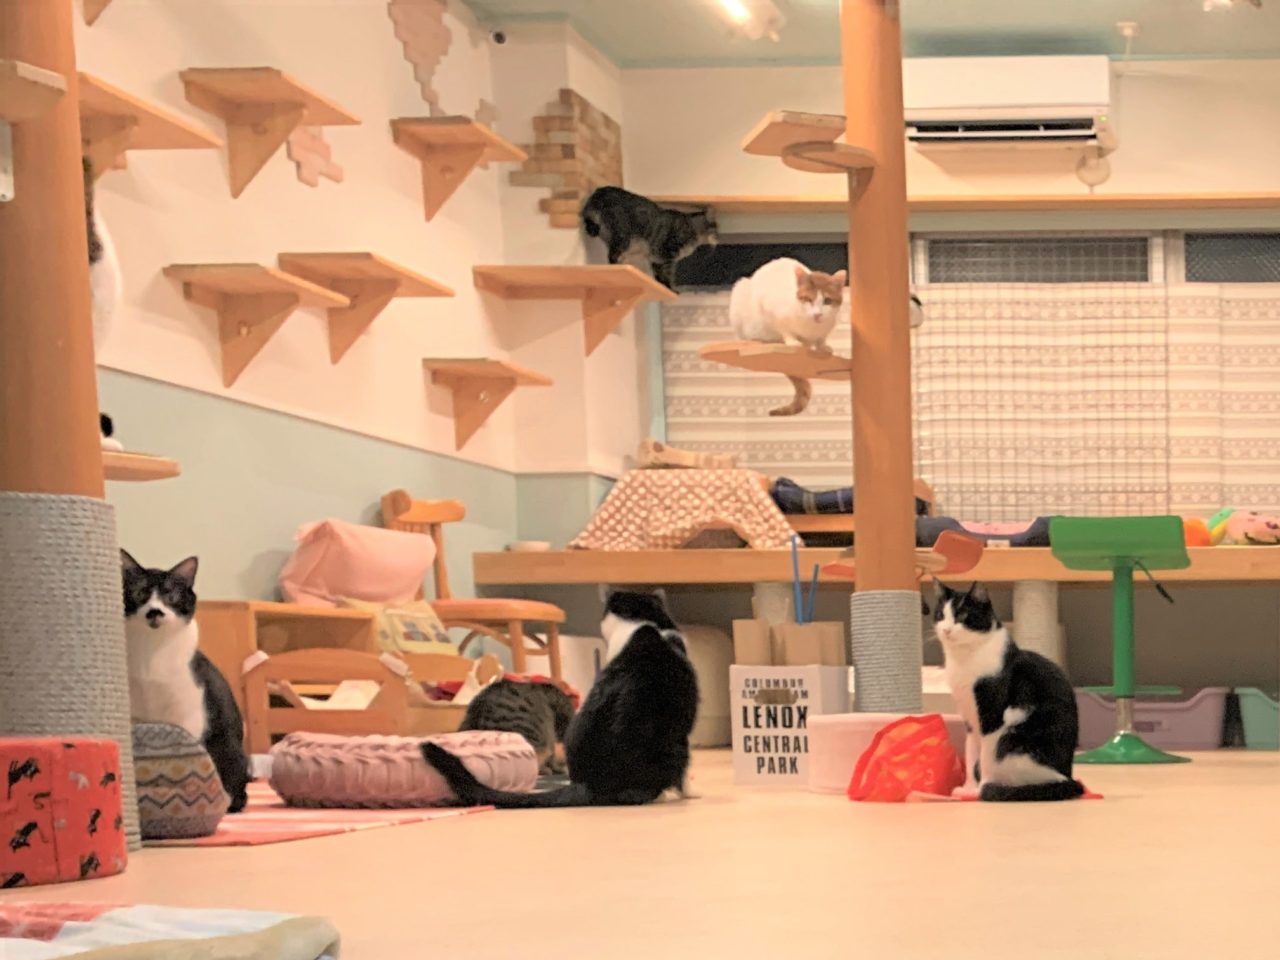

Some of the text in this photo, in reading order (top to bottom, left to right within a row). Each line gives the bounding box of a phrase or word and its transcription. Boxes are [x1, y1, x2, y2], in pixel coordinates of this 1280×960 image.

[742, 705, 808, 729] LENOX
[743, 735, 809, 753] CENTRAL
[756, 756, 799, 774] PARK
